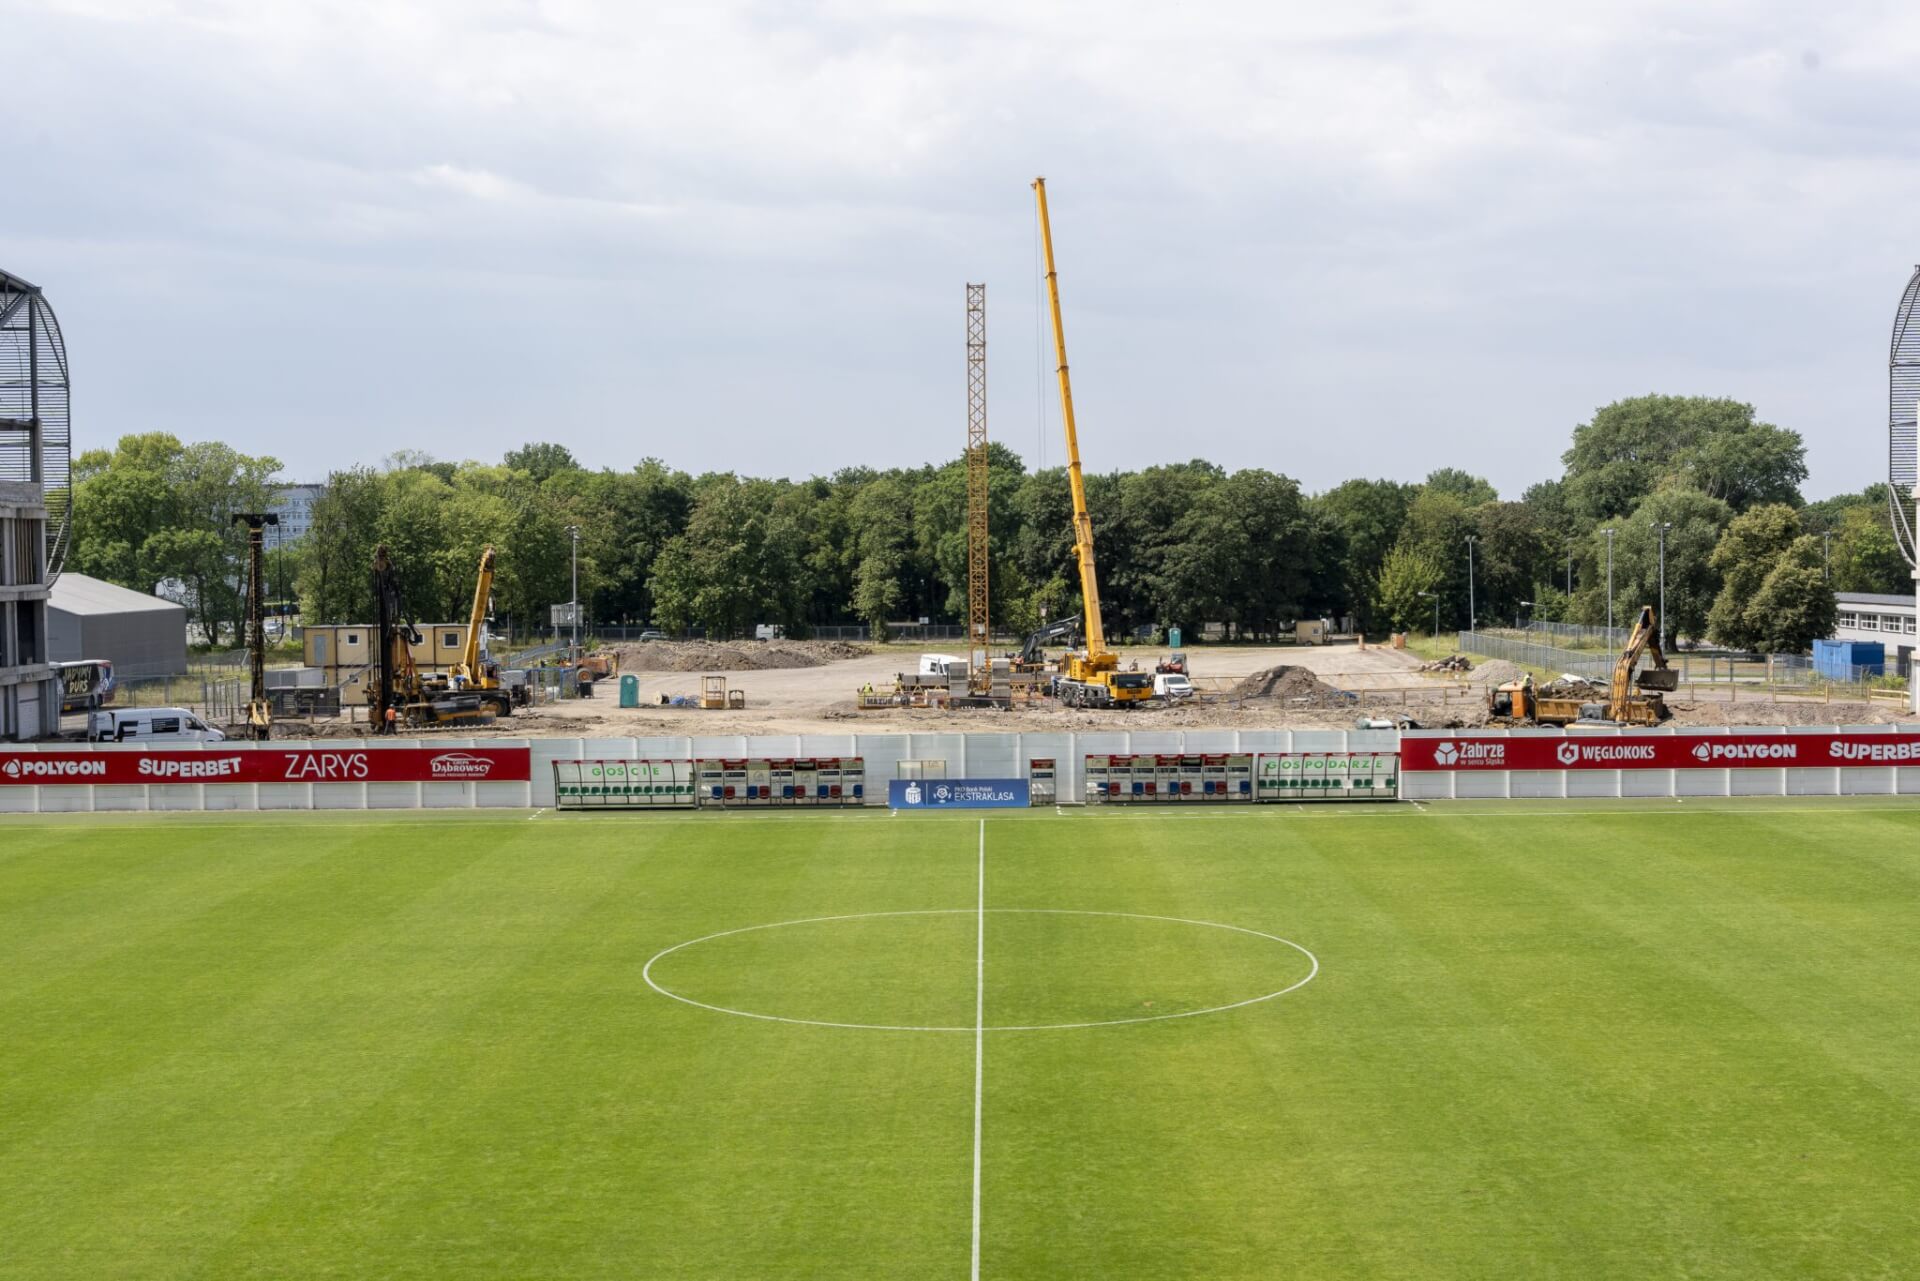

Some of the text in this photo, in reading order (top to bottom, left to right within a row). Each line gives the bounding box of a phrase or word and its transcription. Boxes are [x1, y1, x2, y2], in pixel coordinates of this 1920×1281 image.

[1459, 742, 1505, 759] Zabrze
[1582, 745, 1656, 762] WĘGLOKOKS
[1712, 743, 1797, 758] POLYGON
[22, 761, 106, 775] POLYGON
[138, 757, 242, 777] SUPERBET
[284, 753, 369, 779] ZARYS
[1267, 760, 1384, 769] GOSPODARZE
[954, 792, 1015, 801] EKSTRAKLASA
